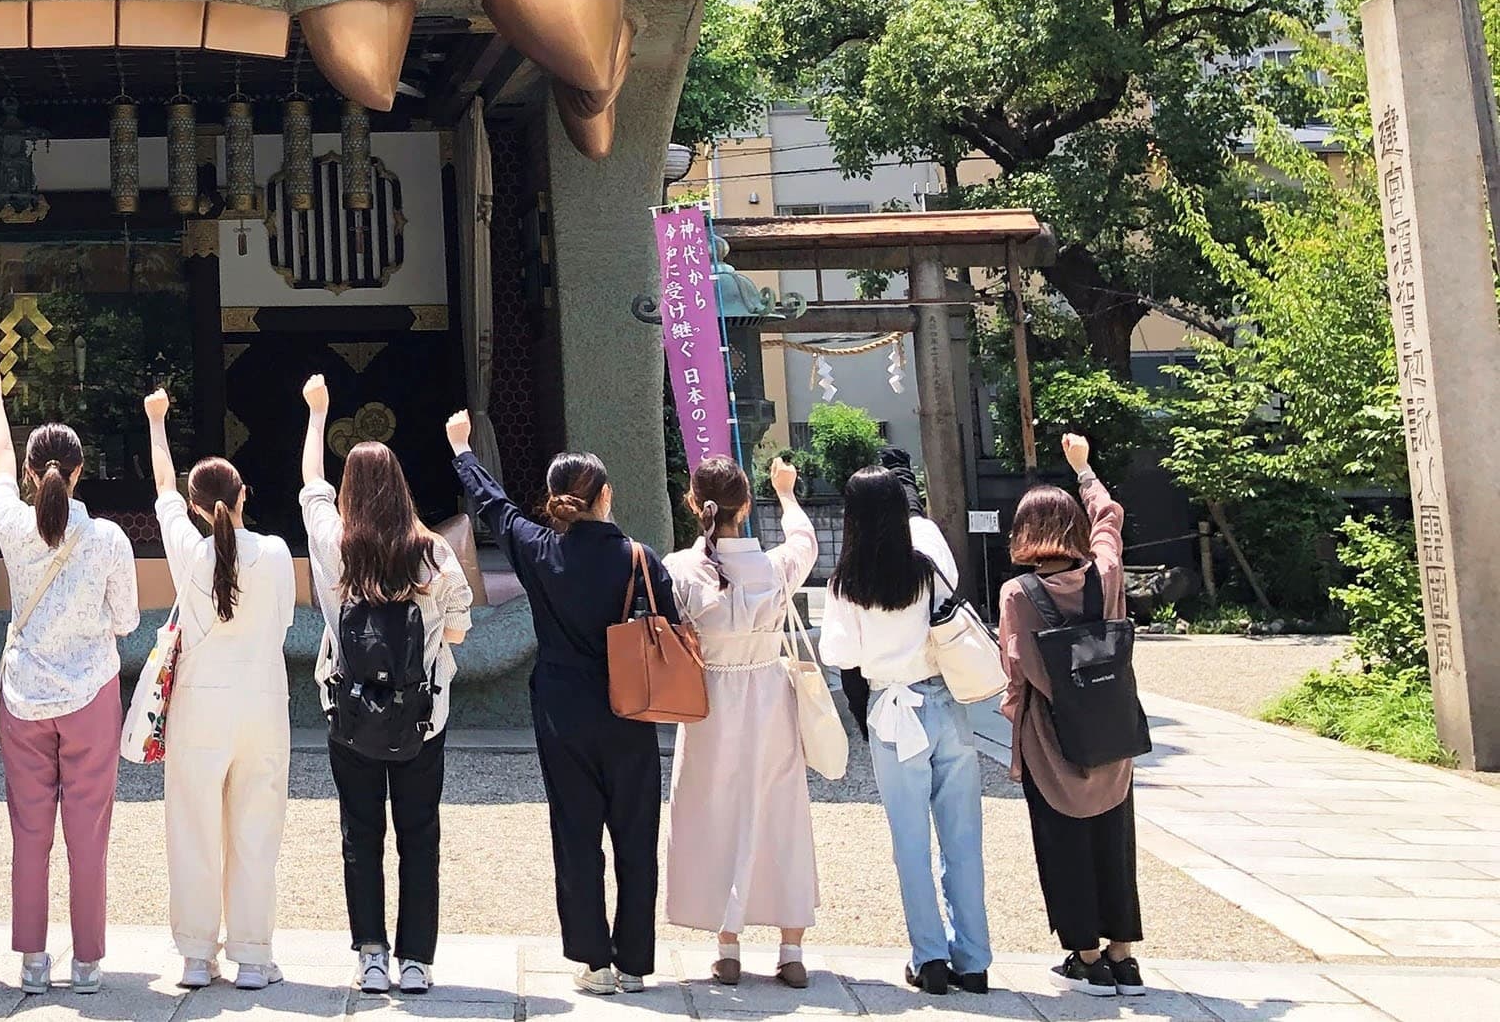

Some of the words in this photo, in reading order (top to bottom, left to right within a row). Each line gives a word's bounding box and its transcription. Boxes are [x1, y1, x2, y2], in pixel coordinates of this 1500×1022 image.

[664, 223, 694, 358] 令和に受け継ぐ
[679, 218, 707, 310] 神代から
